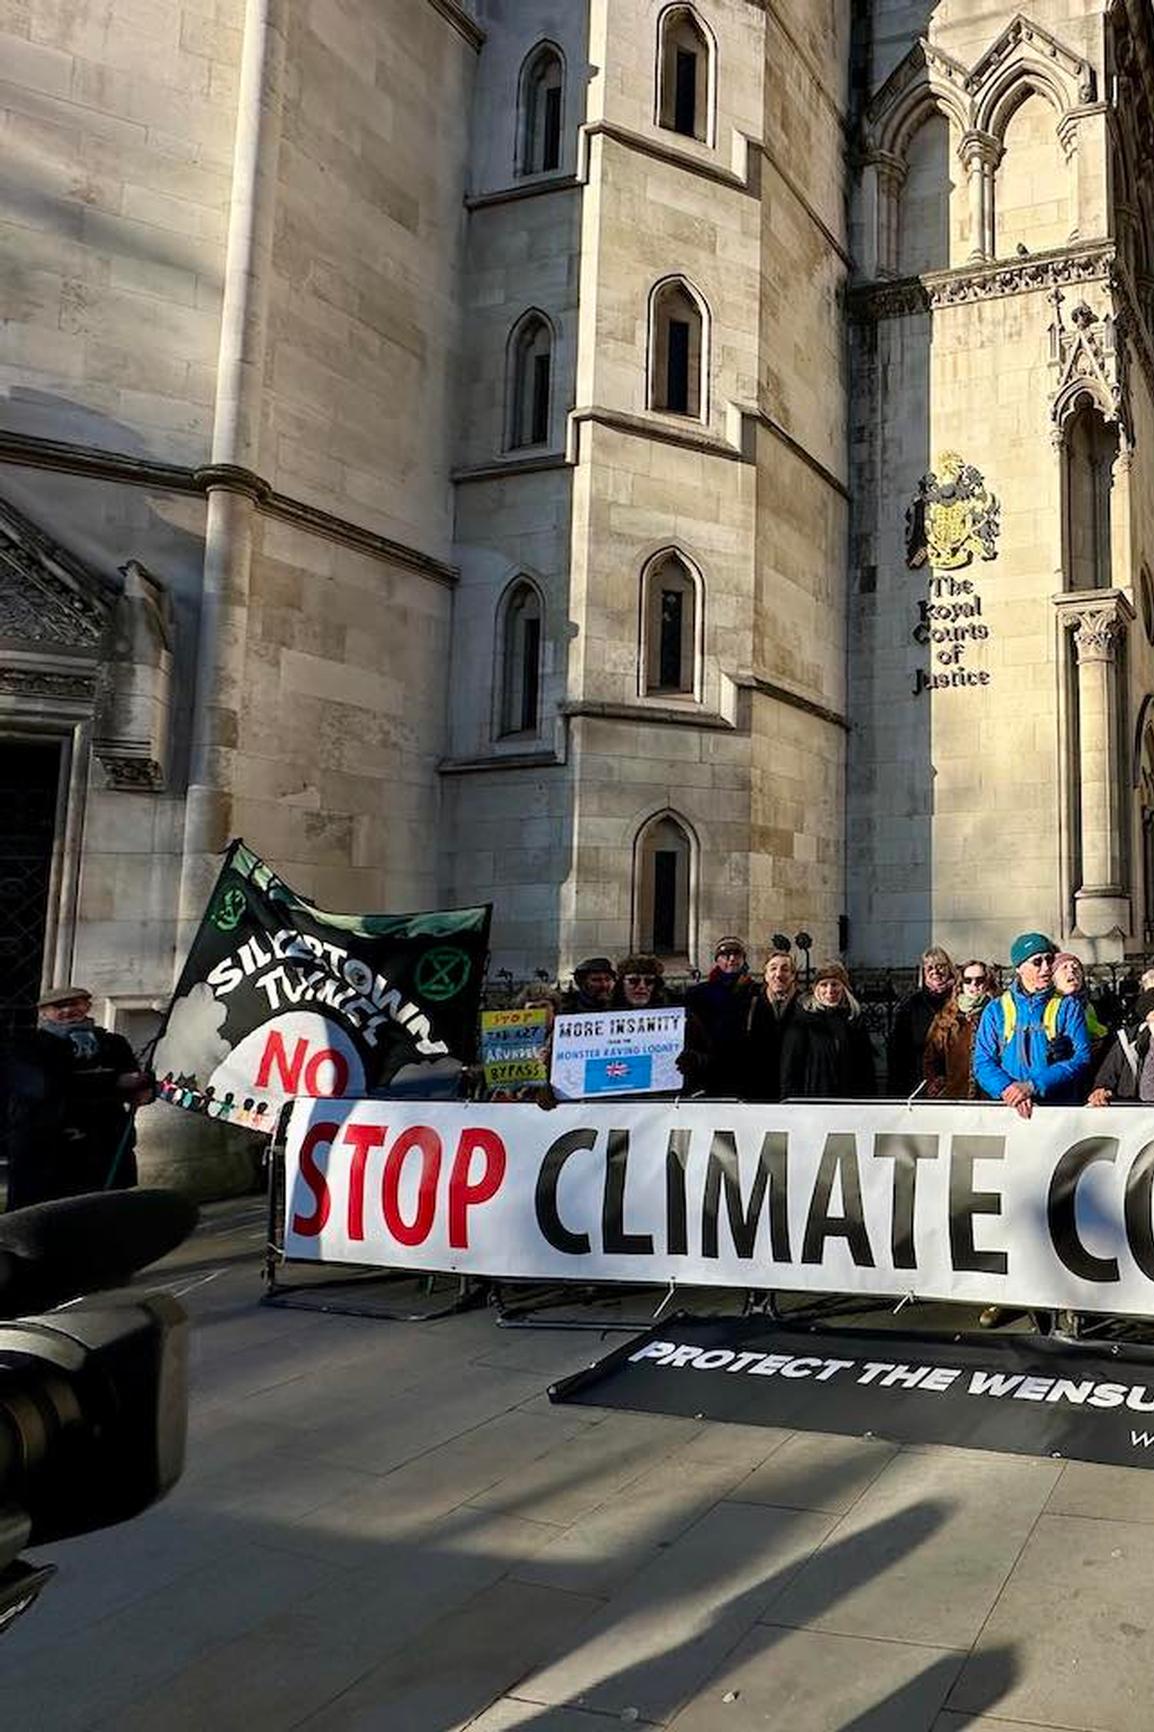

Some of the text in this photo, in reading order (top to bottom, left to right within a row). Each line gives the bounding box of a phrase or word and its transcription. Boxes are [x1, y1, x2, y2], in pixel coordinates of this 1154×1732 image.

[929, 576, 974, 598] The
[918, 595, 982, 623] Royal
[913, 623, 989, 645] Courts
[937, 643, 966, 665] of
[912, 666, 990, 696] Justice
[559, 1015, 681, 1038] MORE INSANITY
[254, 1030, 350, 1098] NO
[490, 1063, 541, 1081] BYPASS
[292, 1121, 507, 1250] STOP
[535, 1127, 1009, 1276] CLIMATE
[628, 1340, 855, 1382] PROTECT
[856, 1362, 962, 1392] THE
